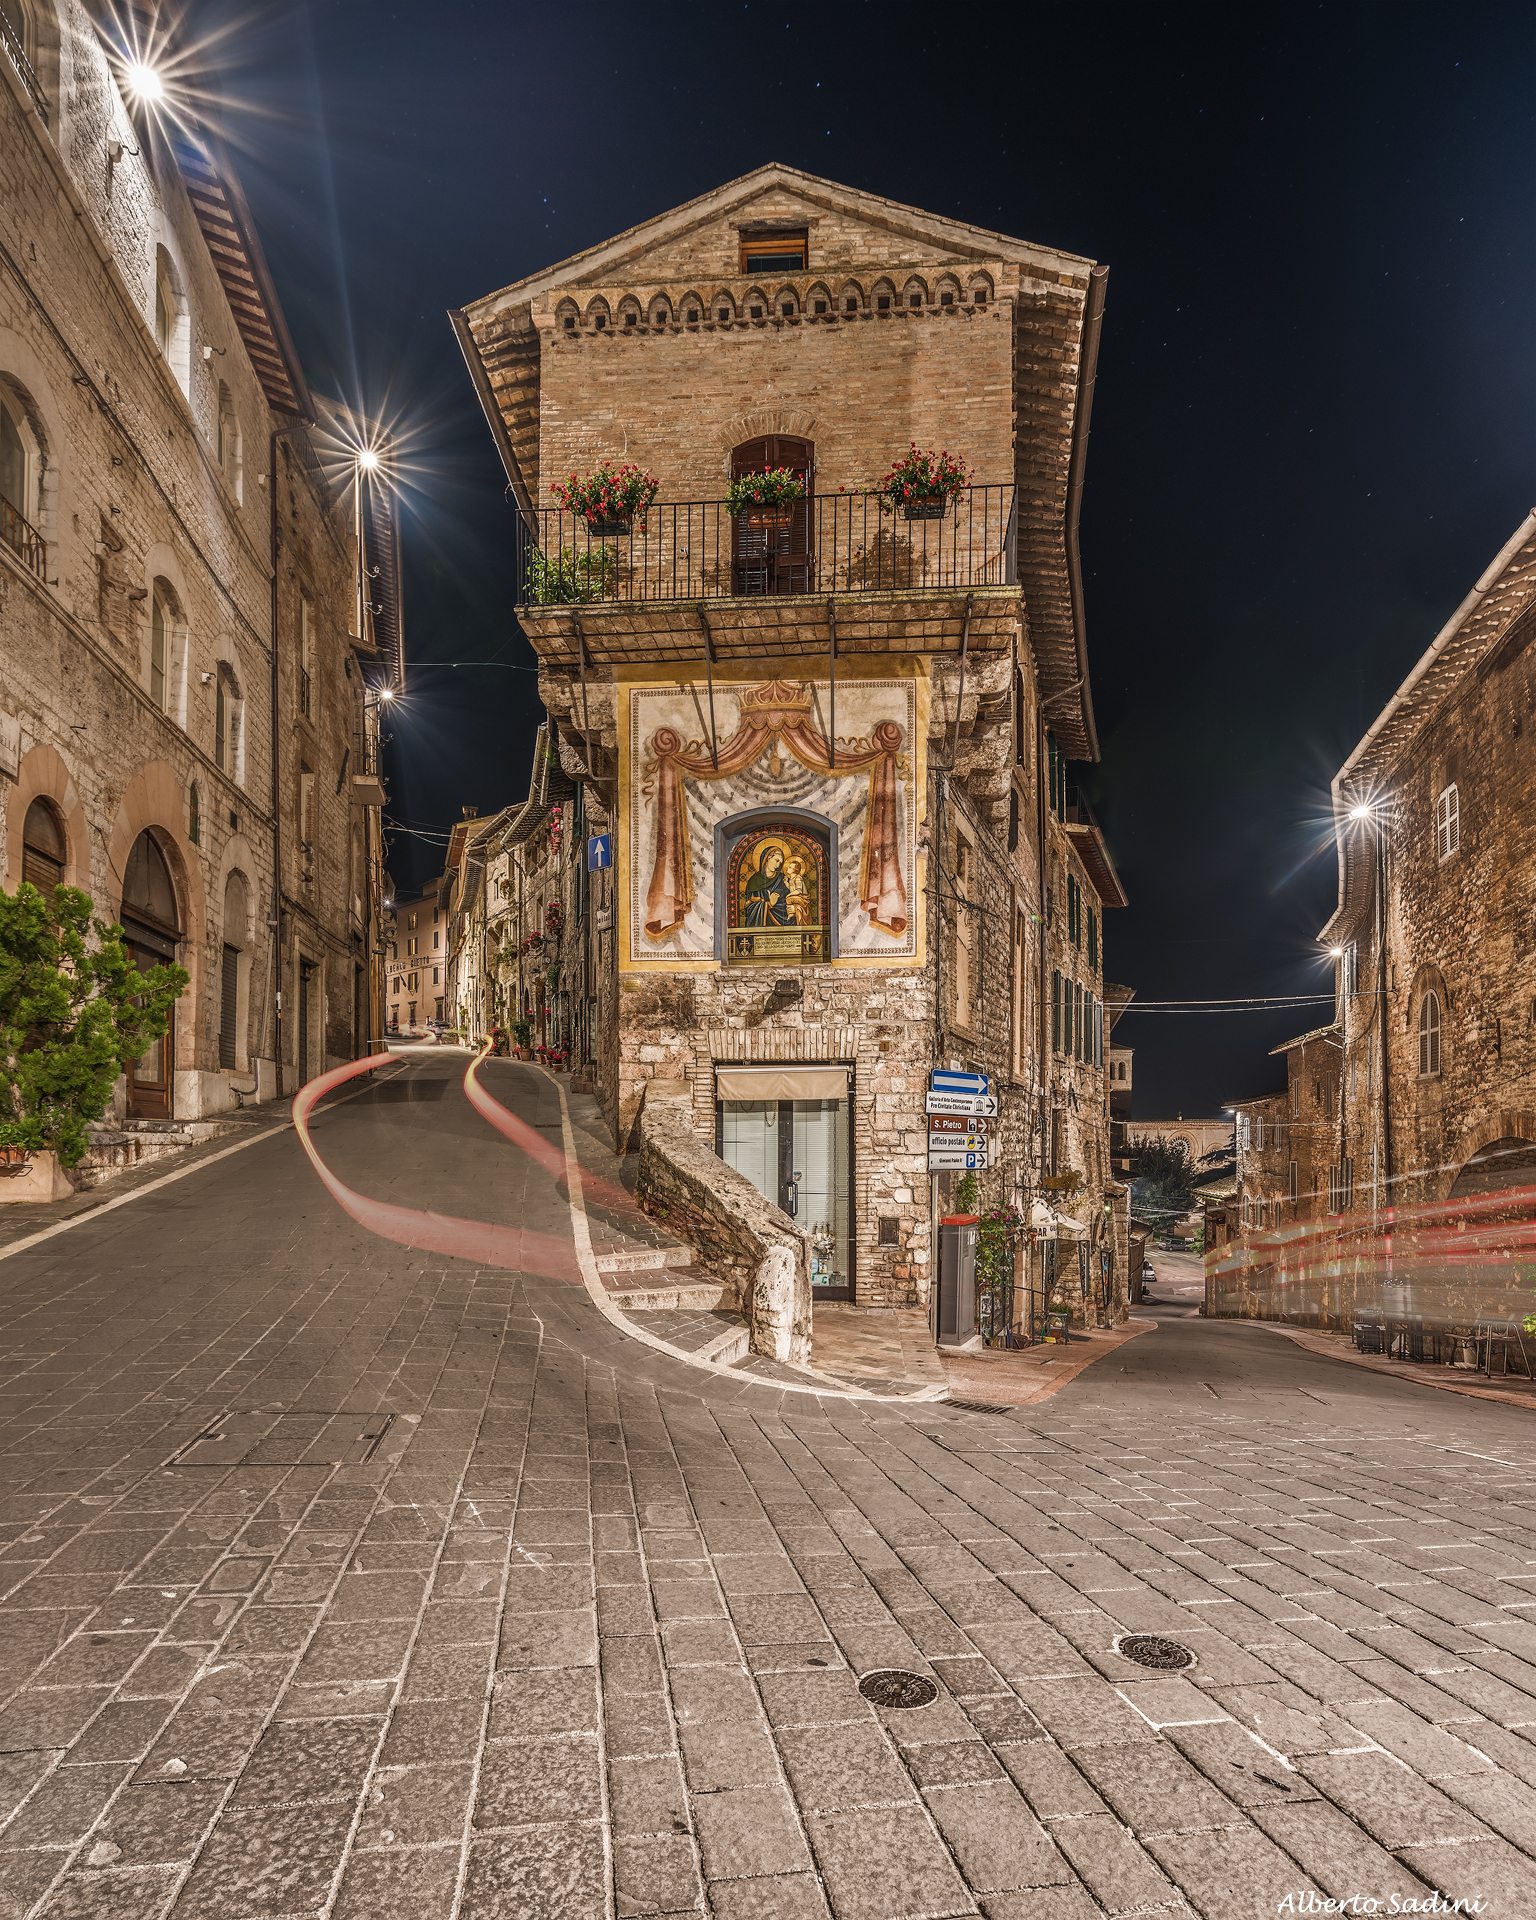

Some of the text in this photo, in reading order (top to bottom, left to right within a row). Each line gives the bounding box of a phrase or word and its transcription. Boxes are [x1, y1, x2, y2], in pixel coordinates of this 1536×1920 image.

[934, 1119, 962, 1129] S. Pietro
[932, 1136, 966, 1147] ufficio postale
[968, 1155, 975, 1166] P
